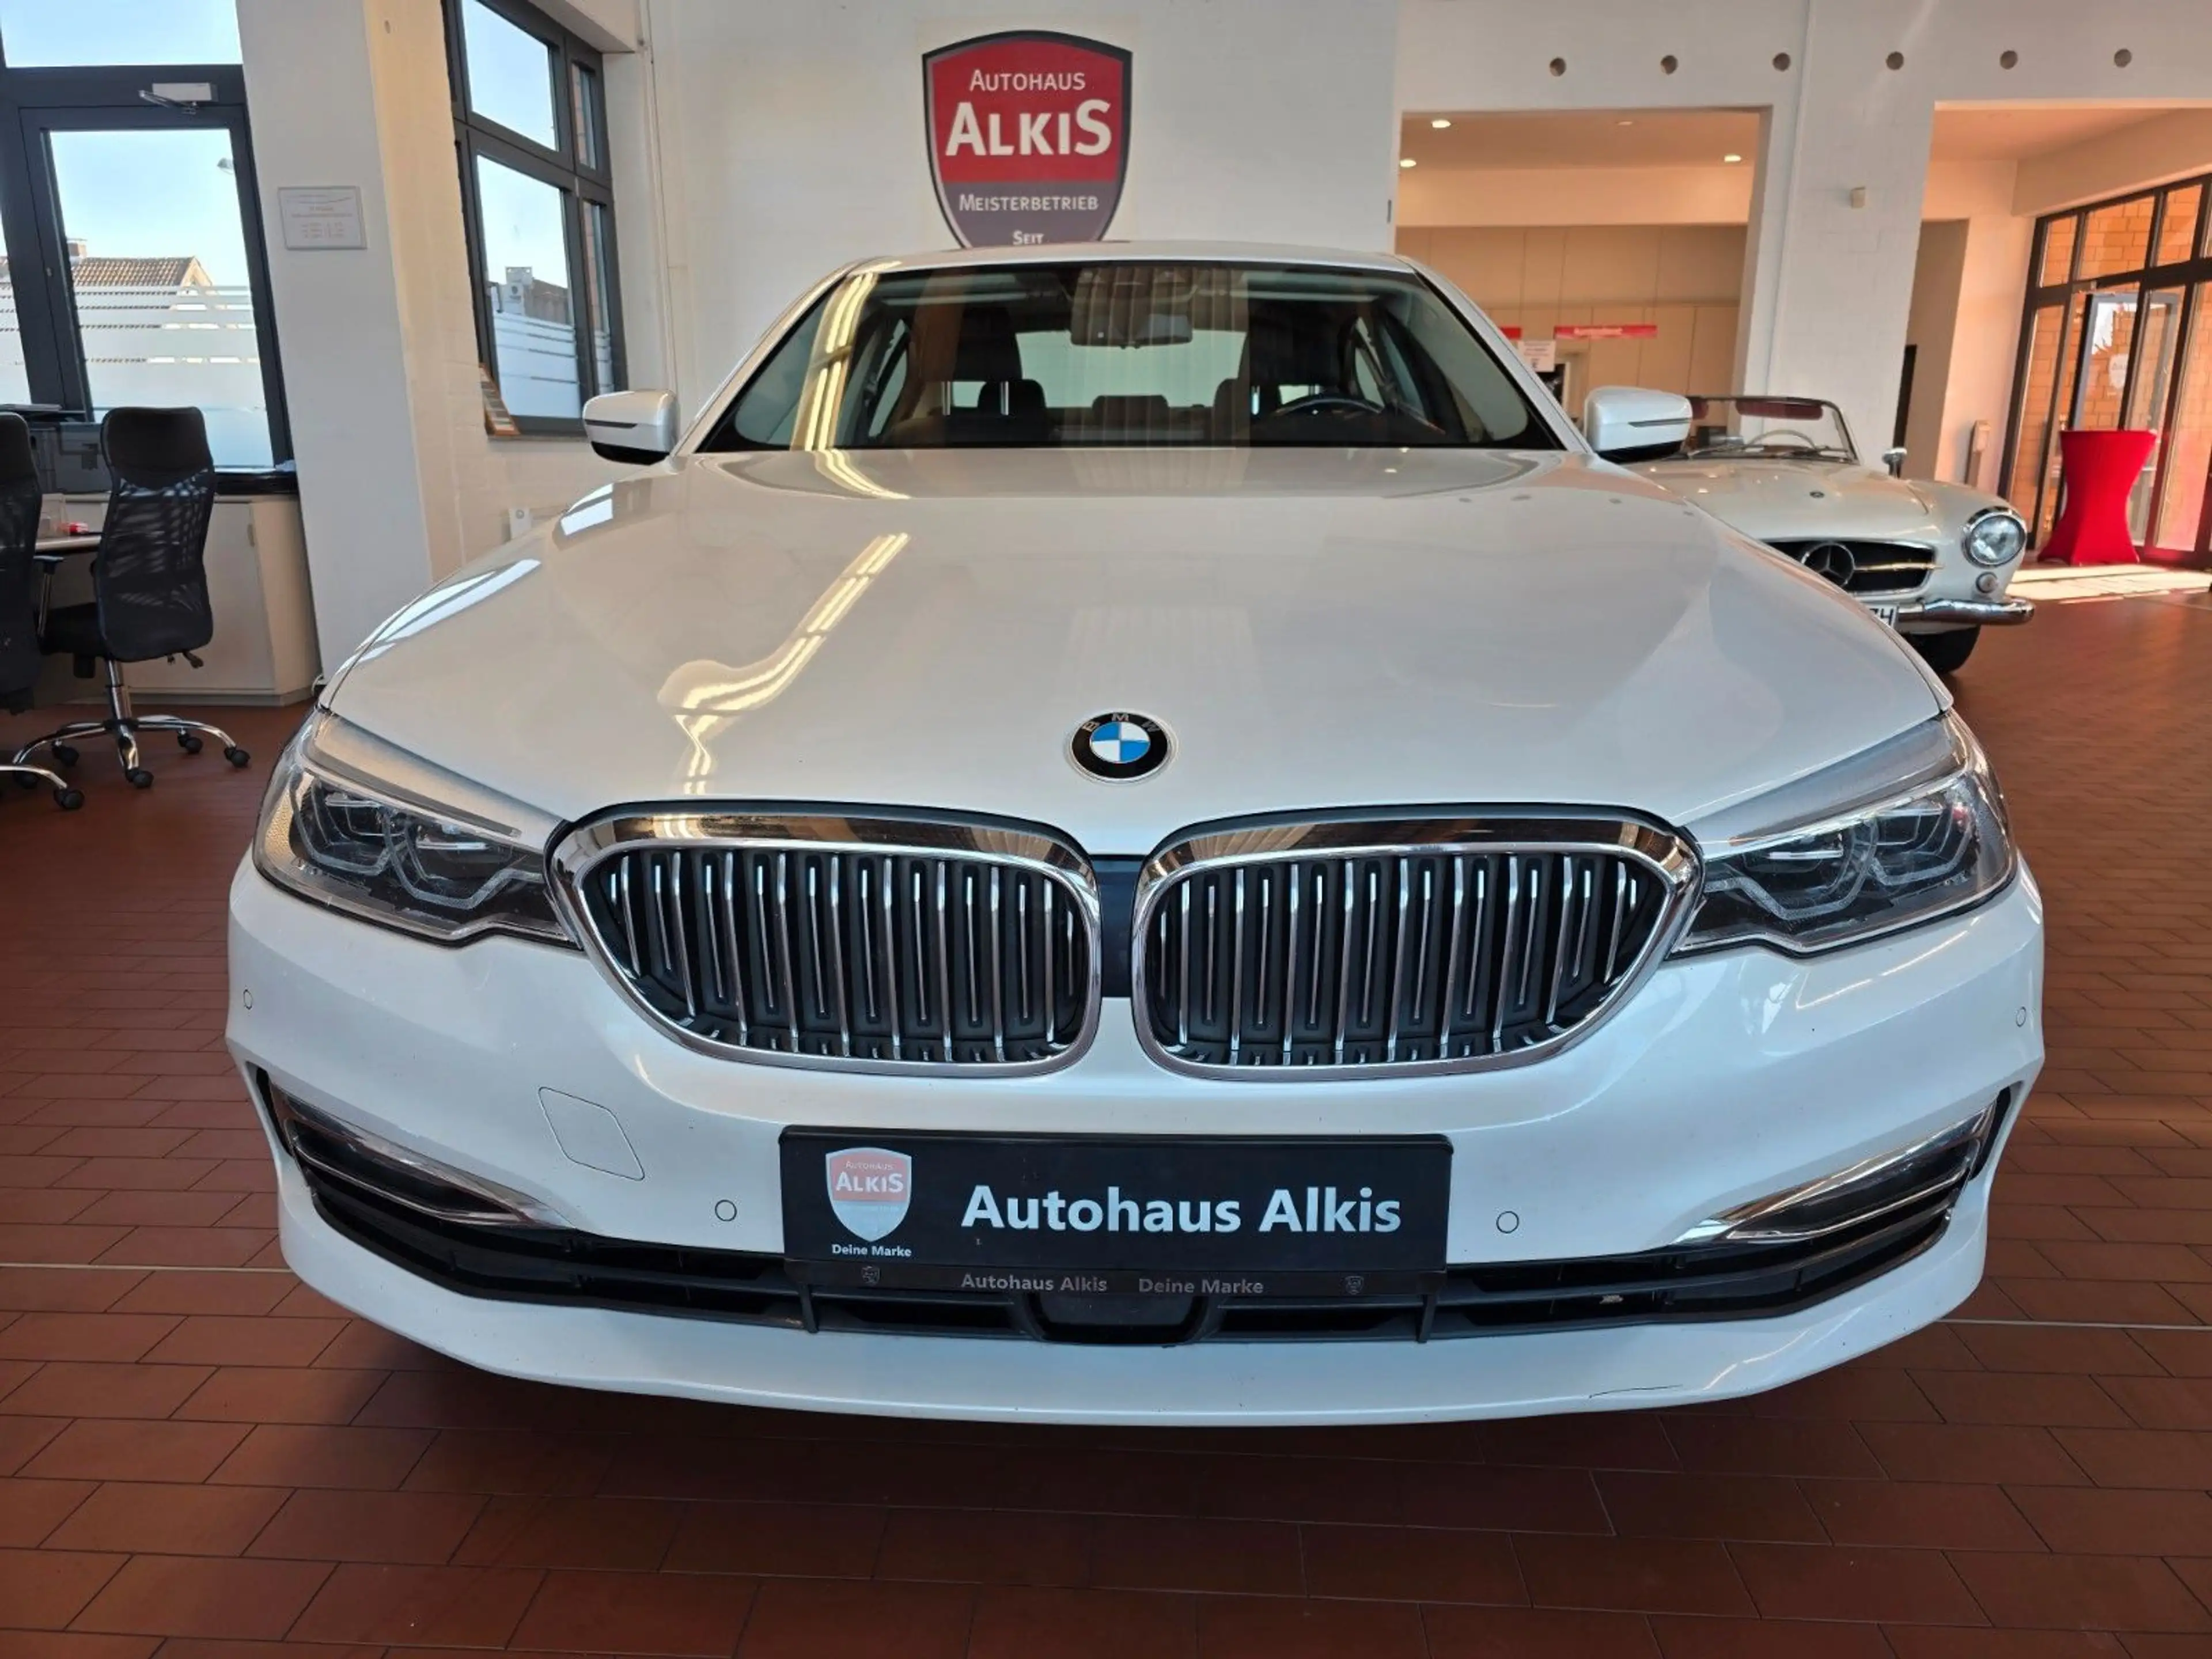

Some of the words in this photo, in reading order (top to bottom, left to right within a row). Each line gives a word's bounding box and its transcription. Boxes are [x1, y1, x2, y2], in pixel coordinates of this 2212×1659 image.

[1081, 712, 1162, 733] BMW
[961, 1185, 1241, 1233] Autohaus
[1259, 1187, 1401, 1233] Alkis
[832, 1244, 868, 1255] Deine
[872, 1245, 912, 1257] Marke
[961, 1273, 1054, 1291] Autohaus
[1060, 1277, 1107, 1291] Alkis
[1139, 1278, 1195, 1293] Deine
[1201, 1279, 1264, 1294] Marke
